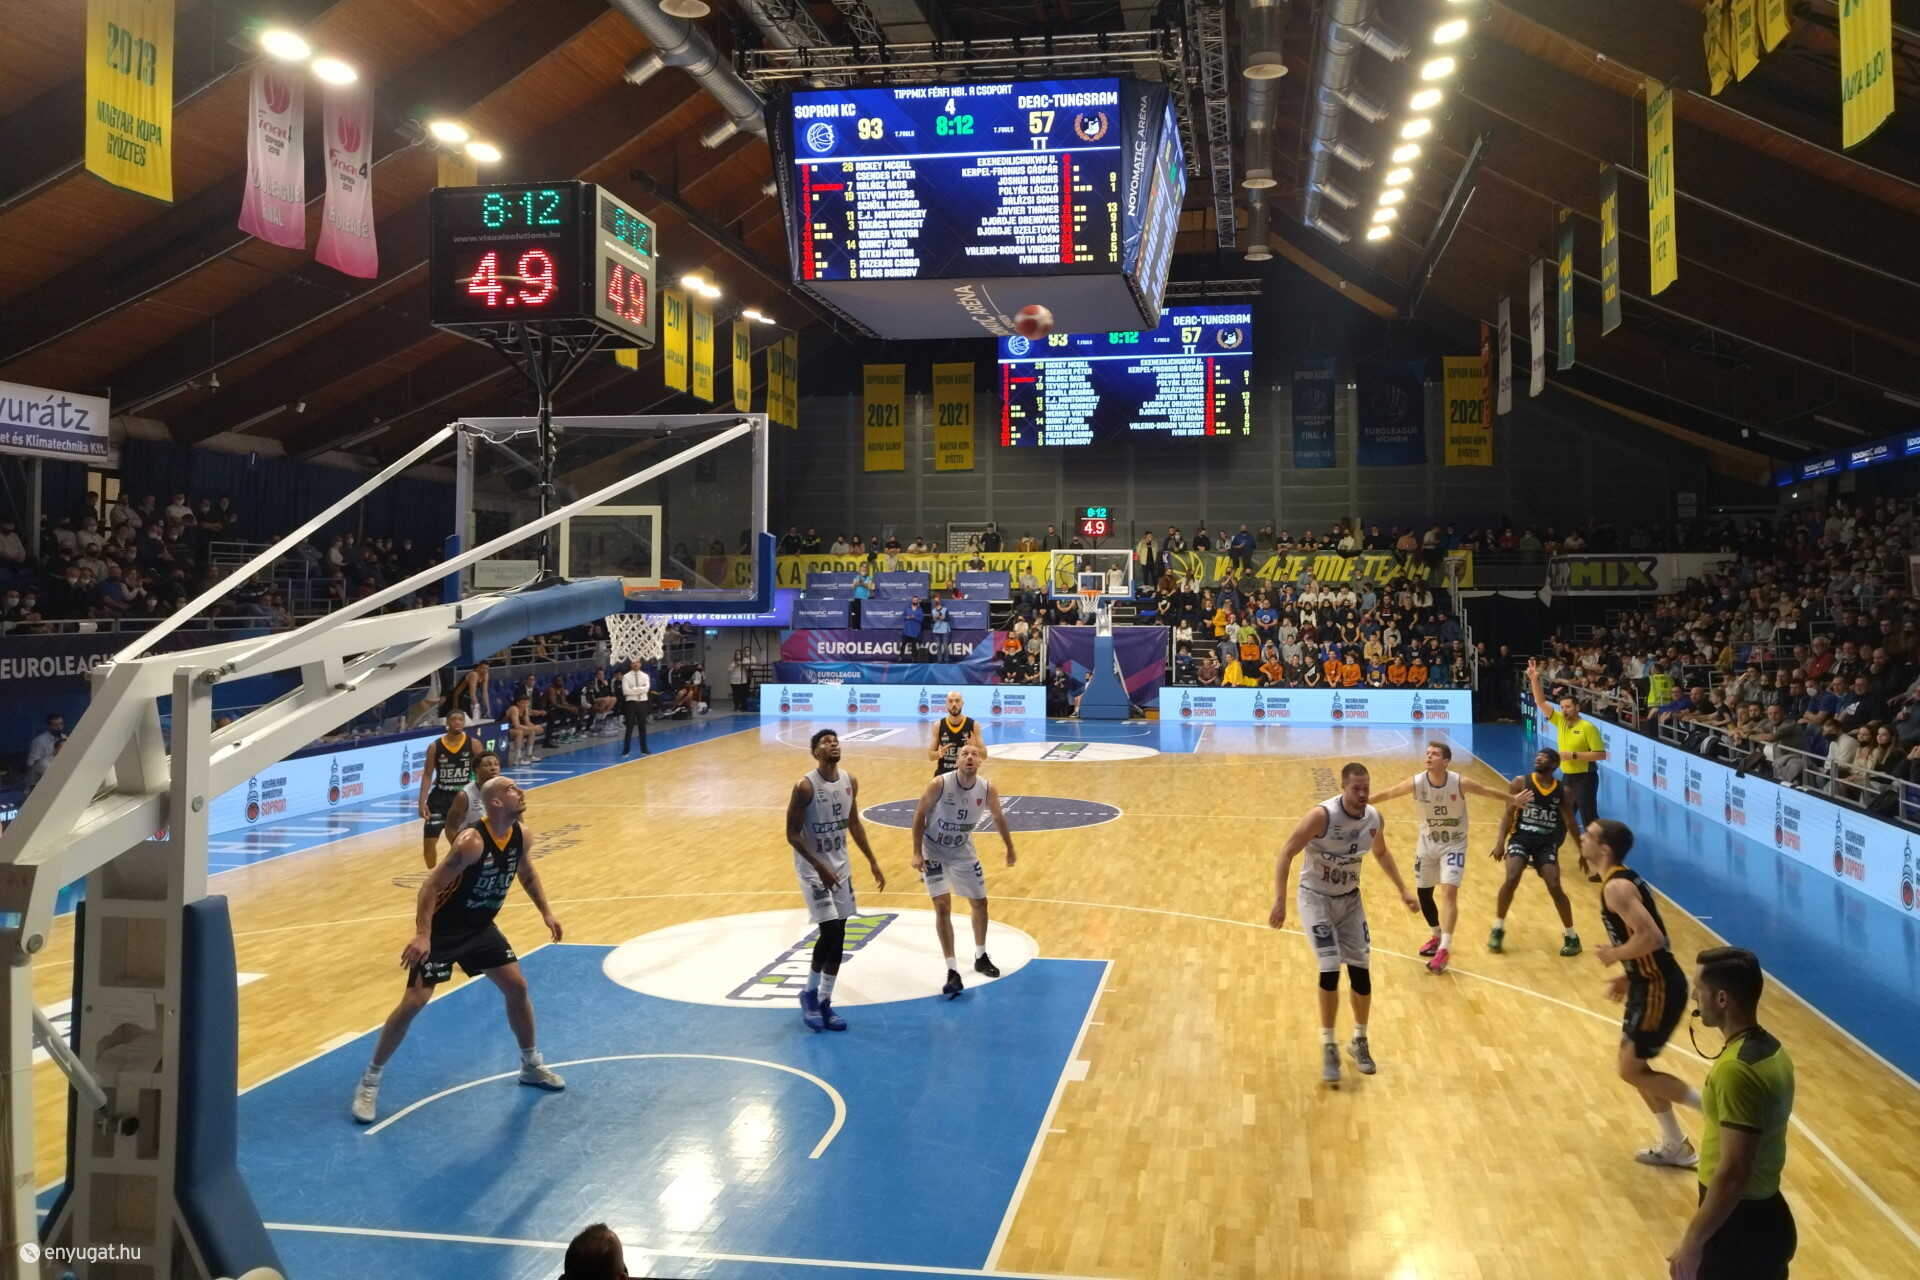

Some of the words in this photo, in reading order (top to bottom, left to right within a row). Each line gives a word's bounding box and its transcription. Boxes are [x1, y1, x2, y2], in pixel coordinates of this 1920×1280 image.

[106, 22, 156, 86] 2013
[894, 88, 926, 99] TIPPMIX
[928, 87, 950, 98] FÉRFI
[976, 85, 1013, 96] CSOPORT
[945, 98, 956, 114] 4
[1018, 92, 1118, 108] DEAC-TUNGSRAM
[794, 104, 838, 118] SOPRON
[841, 104, 856, 116] KC
[97, 99, 134, 135] MAGYAR
[137, 118, 162, 147] KUPA
[858, 118, 884, 140] 93
[936, 115, 974, 136] 8:12
[1029, 111, 1055, 134] 57
[1128, 141, 1144, 216] NOVOMATIC
[1138, 96, 1148, 138] ARENA
[358, 162, 368, 178] 4
[892, 170, 916, 179] PÉTER
[1110, 172, 1116, 182] 9
[847, 182, 852, 191] 7
[998, 186, 1028, 196] POLYÁK
[1030, 185, 1058, 194] LÁSZLÓ
[1110, 183, 1116, 192] 1
[857, 191, 886, 200] TEYVON
[888, 190, 914, 199] MYERS
[484, 190, 560, 227] 8:12
[998, 206, 1026, 216] XAVIER
[1027, 205, 1058, 214] THAMES
[1107, 202, 1118, 212] 13
[846, 211, 854, 220] 11
[858, 211, 872, 220] E.J.
[874, 210, 926, 219] MONTGOMERY
[614, 208, 648, 256] 8:12
[848, 221, 854, 230] 3
[1111, 223, 1116, 232] 1
[454, 232, 560, 243] www.visualsolutions.hu
[1016, 236, 1036, 244] TÓTH
[846, 240, 856, 250] 14
[1027, 244, 1060, 254] VINCENT
[1110, 242, 1117, 252] 5
[850, 260, 856, 268] 5
[1019, 256, 1038, 264] IVAN
[1108, 252, 1118, 262] 11
[469, 248, 552, 306] 4.9
[850, 269, 856, 278] 6
[608, 264, 644, 325] 4.9
[954, 285, 988, 315] ARENA
[1173, 314, 1250, 326] DEAC-TUNGSRAM
[1182, 327, 1202, 343] 57
[868, 404, 900, 427] 2021
[939, 403, 969, 426] 2021
[1450, 400, 1484, 424] 2020
[12, 432, 24, 445] és
[26, 434, 88, 453] Klimatechnika
[90, 442, 106, 454] Kft.
[1302, 432, 1320, 440] FINAL
[1084, 521, 1104, 534] 4.9
[790, 562, 802, 584] A
[1314, 556, 1358, 582] ONE
[817, 642, 912, 656] EUROLEAGUE
[0, 654, 112, 680] EUROLEAG
[440, 768, 470, 779] DEAC
[832, 803, 842, 816] 12
[956, 810, 968, 820] 51
[1434, 806, 1448, 816] 20
[1522, 808, 1558, 822] DEAC
[1448, 852, 1464, 868] 20
[476, 872, 514, 888] DEAC
